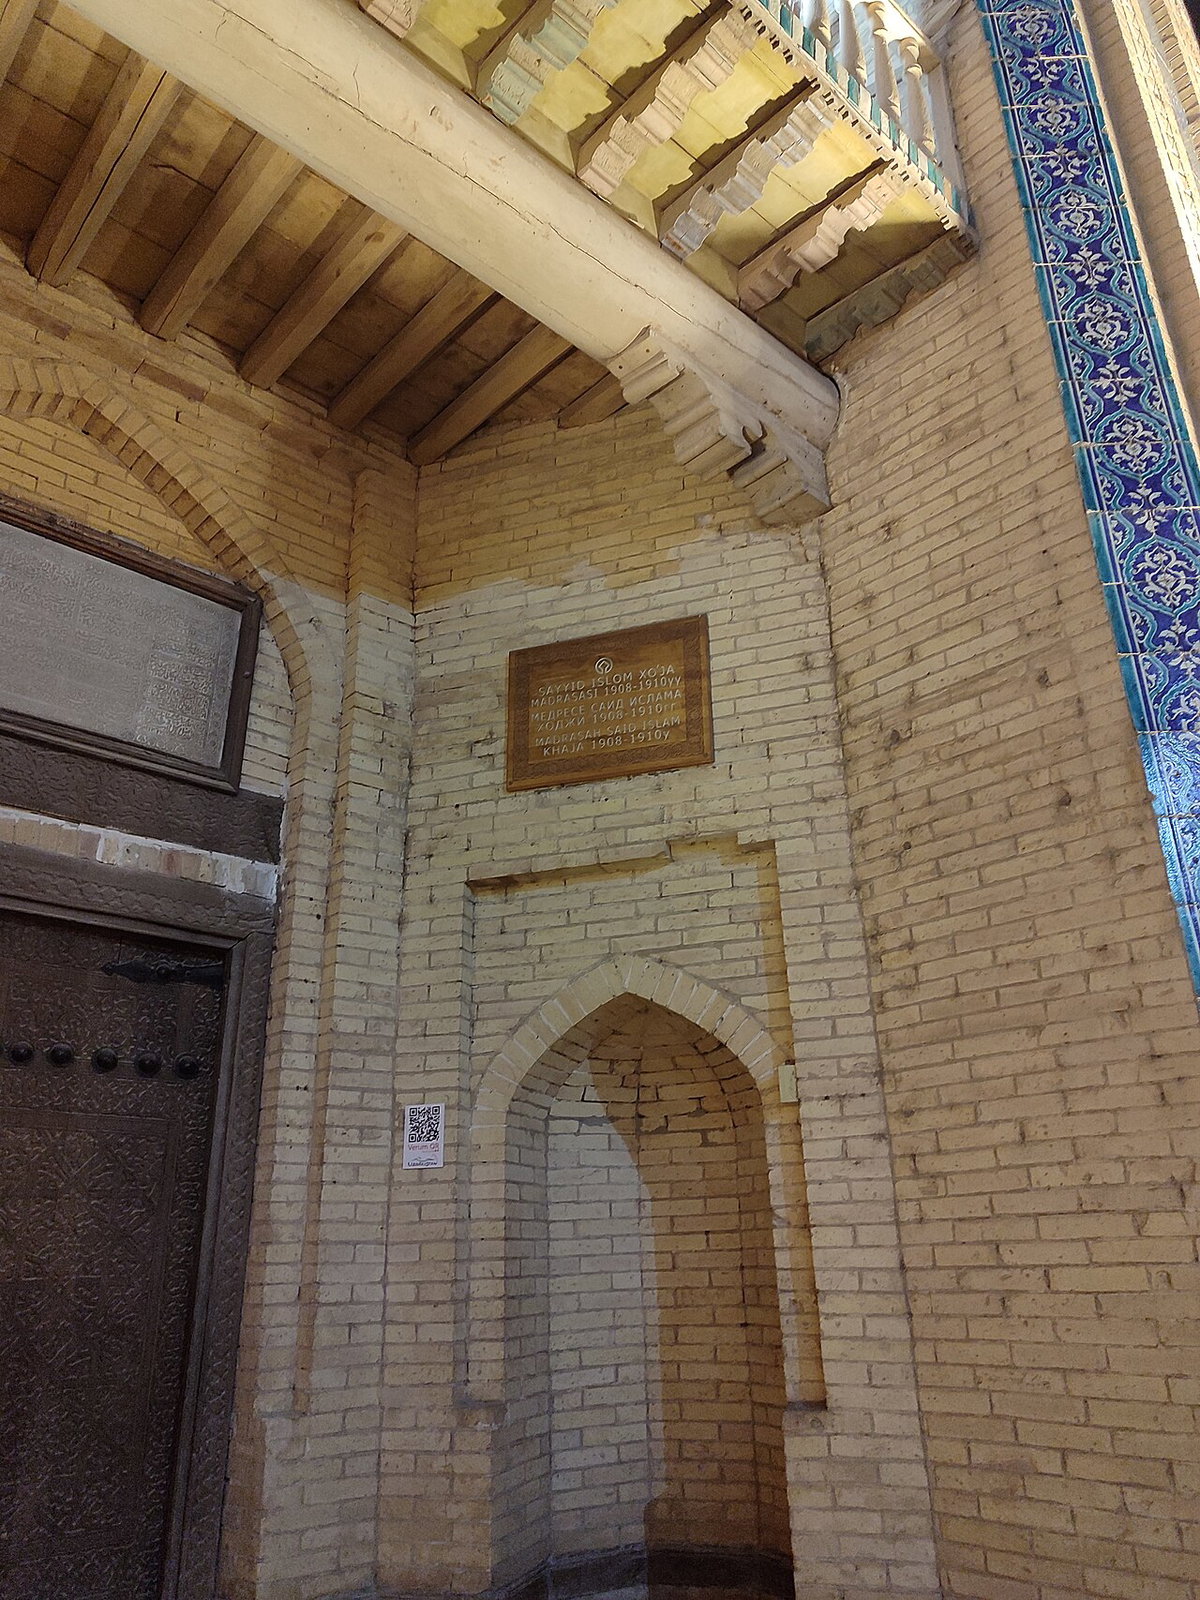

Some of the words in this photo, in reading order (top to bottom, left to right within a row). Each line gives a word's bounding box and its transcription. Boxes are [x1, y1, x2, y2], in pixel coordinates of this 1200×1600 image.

[538, 680, 585, 697] SAYYID
[592, 672, 633, 688] ISLOM
[530, 688, 598, 708] MADRASASI
[531, 704, 585, 722] МЕДРЕСЕ
[590, 698, 624, 713] САИД
[629, 689, 682, 707] ИСЛАМА
[534, 728, 601, 747] MADRASAH
[606, 722, 636, 736] SAID
[642, 715, 681, 731] ISLAM
[537, 715, 585, 732] ХОДЖИ
[543, 742, 584, 757] KHAJA
